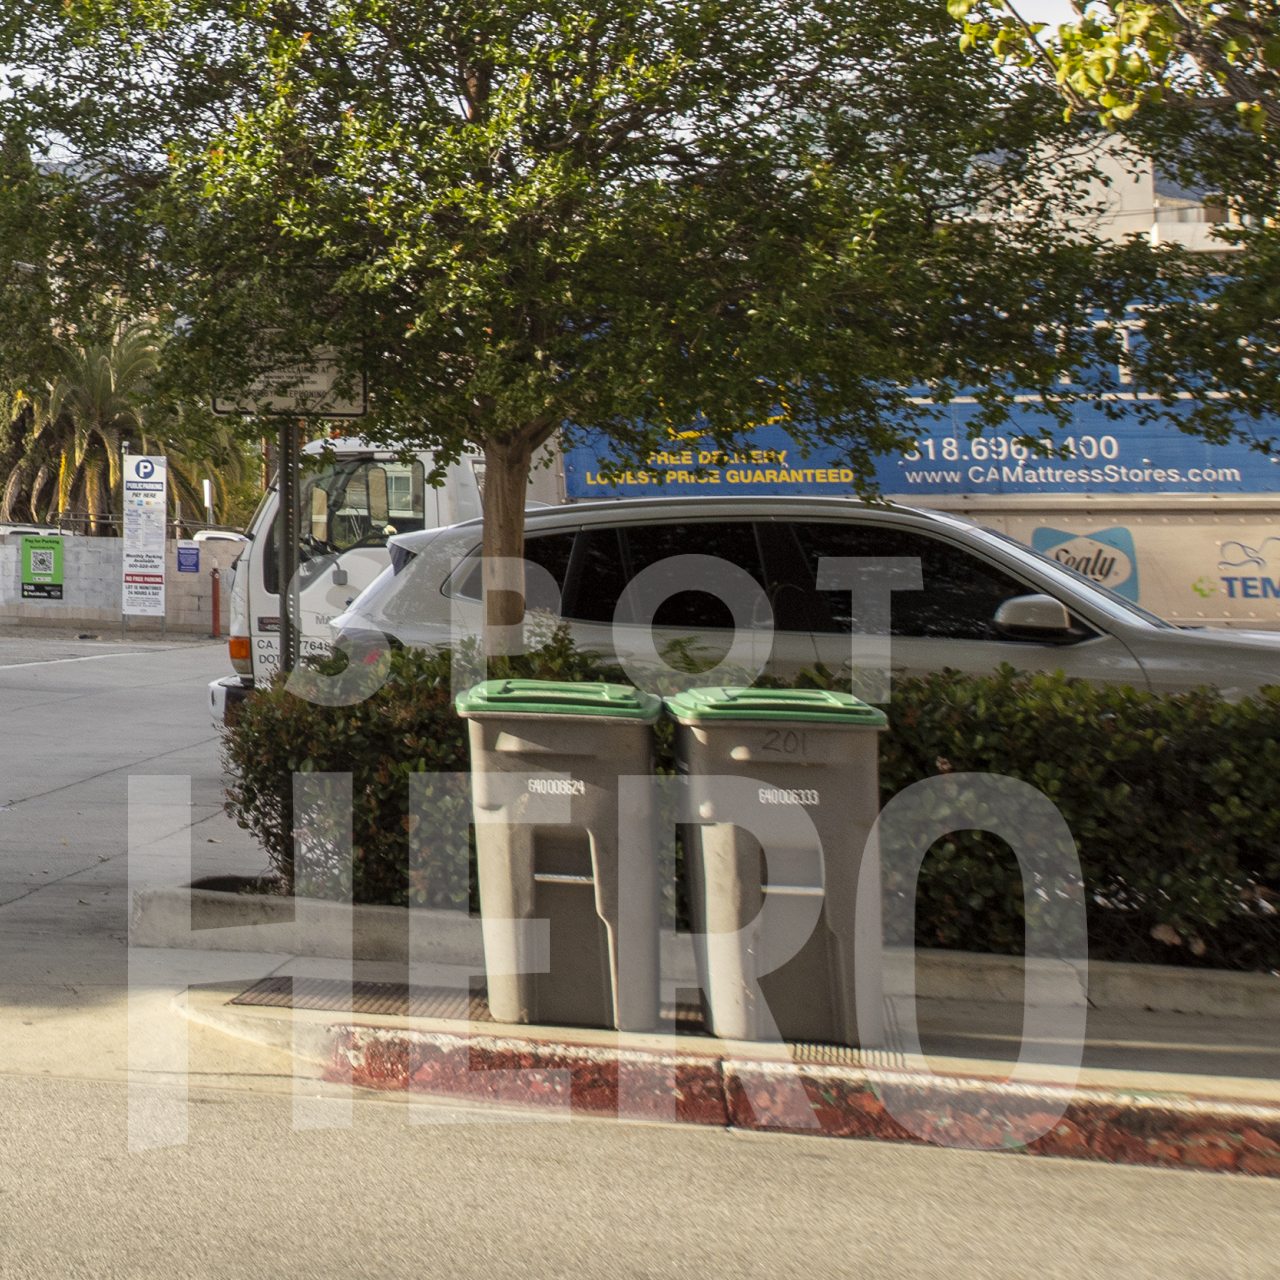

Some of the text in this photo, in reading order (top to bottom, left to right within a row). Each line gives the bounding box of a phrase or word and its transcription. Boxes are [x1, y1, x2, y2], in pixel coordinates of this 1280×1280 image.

[278, 366, 318, 374] RECLAIMD
[648, 451, 693, 464] FREE
[726, 469, 853, 483] GUARANTEED
